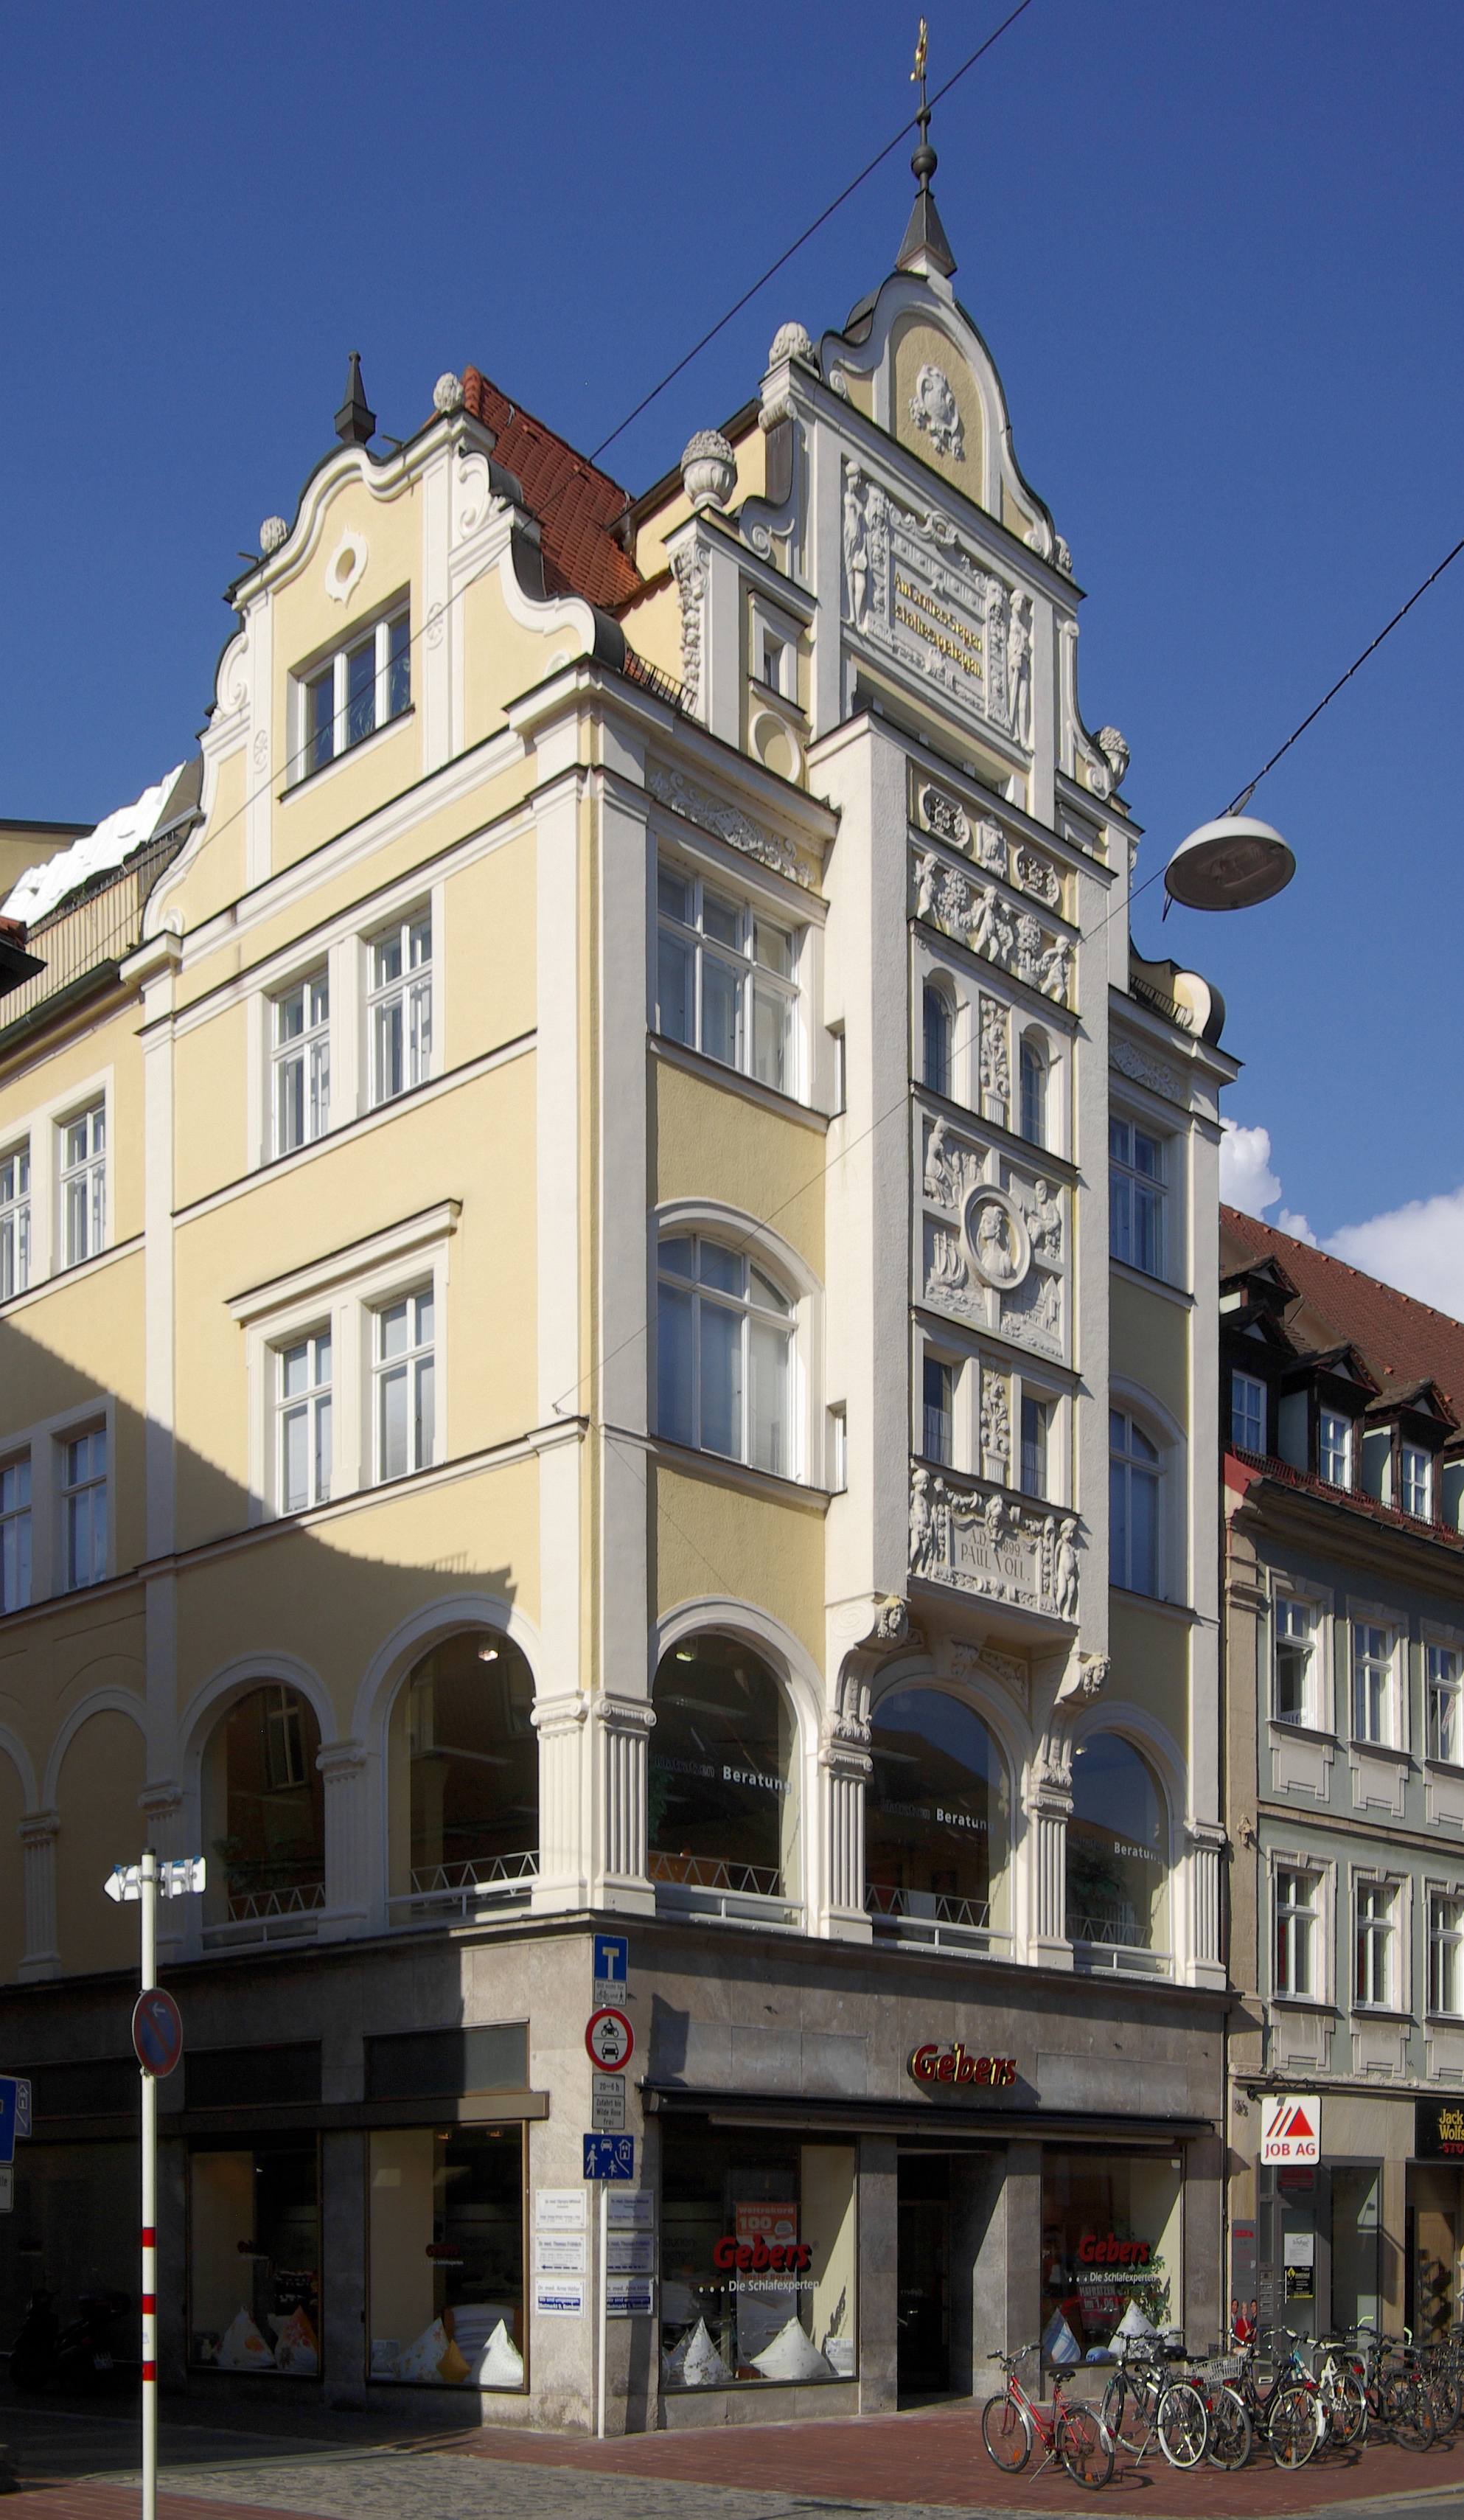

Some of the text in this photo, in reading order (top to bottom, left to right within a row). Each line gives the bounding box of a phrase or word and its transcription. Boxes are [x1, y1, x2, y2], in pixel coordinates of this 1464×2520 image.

[961, 1542, 991, 1570] PAUL
[722, 1764, 792, 1795] Beratung
[935, 1807, 995, 1834] Beratung
[911, 2042, 1018, 2086] Gebers
[616, 2081, 620, 2092] h
[596, 2098, 613, 2106] Zufahrt
[596, 2108, 609, 2116] Wilde
[1438, 2108, 1464, 2125] Jack
[603, 2117, 614, 2126] frei
[1265, 2142, 1317, 2159] JOB AG
[739, 2206, 795, 2215] Weltrekord
[739, 2216, 773, 2230] 100
[713, 2235, 809, 2270] Gebers
[1079, 2233, 1148, 2263] Gebers
[1089, 2271, 1102, 2283] Die
[1104, 2271, 1157, 2285] Schlafexperten
[728, 2279, 820, 2294] Die Schlafexperten
